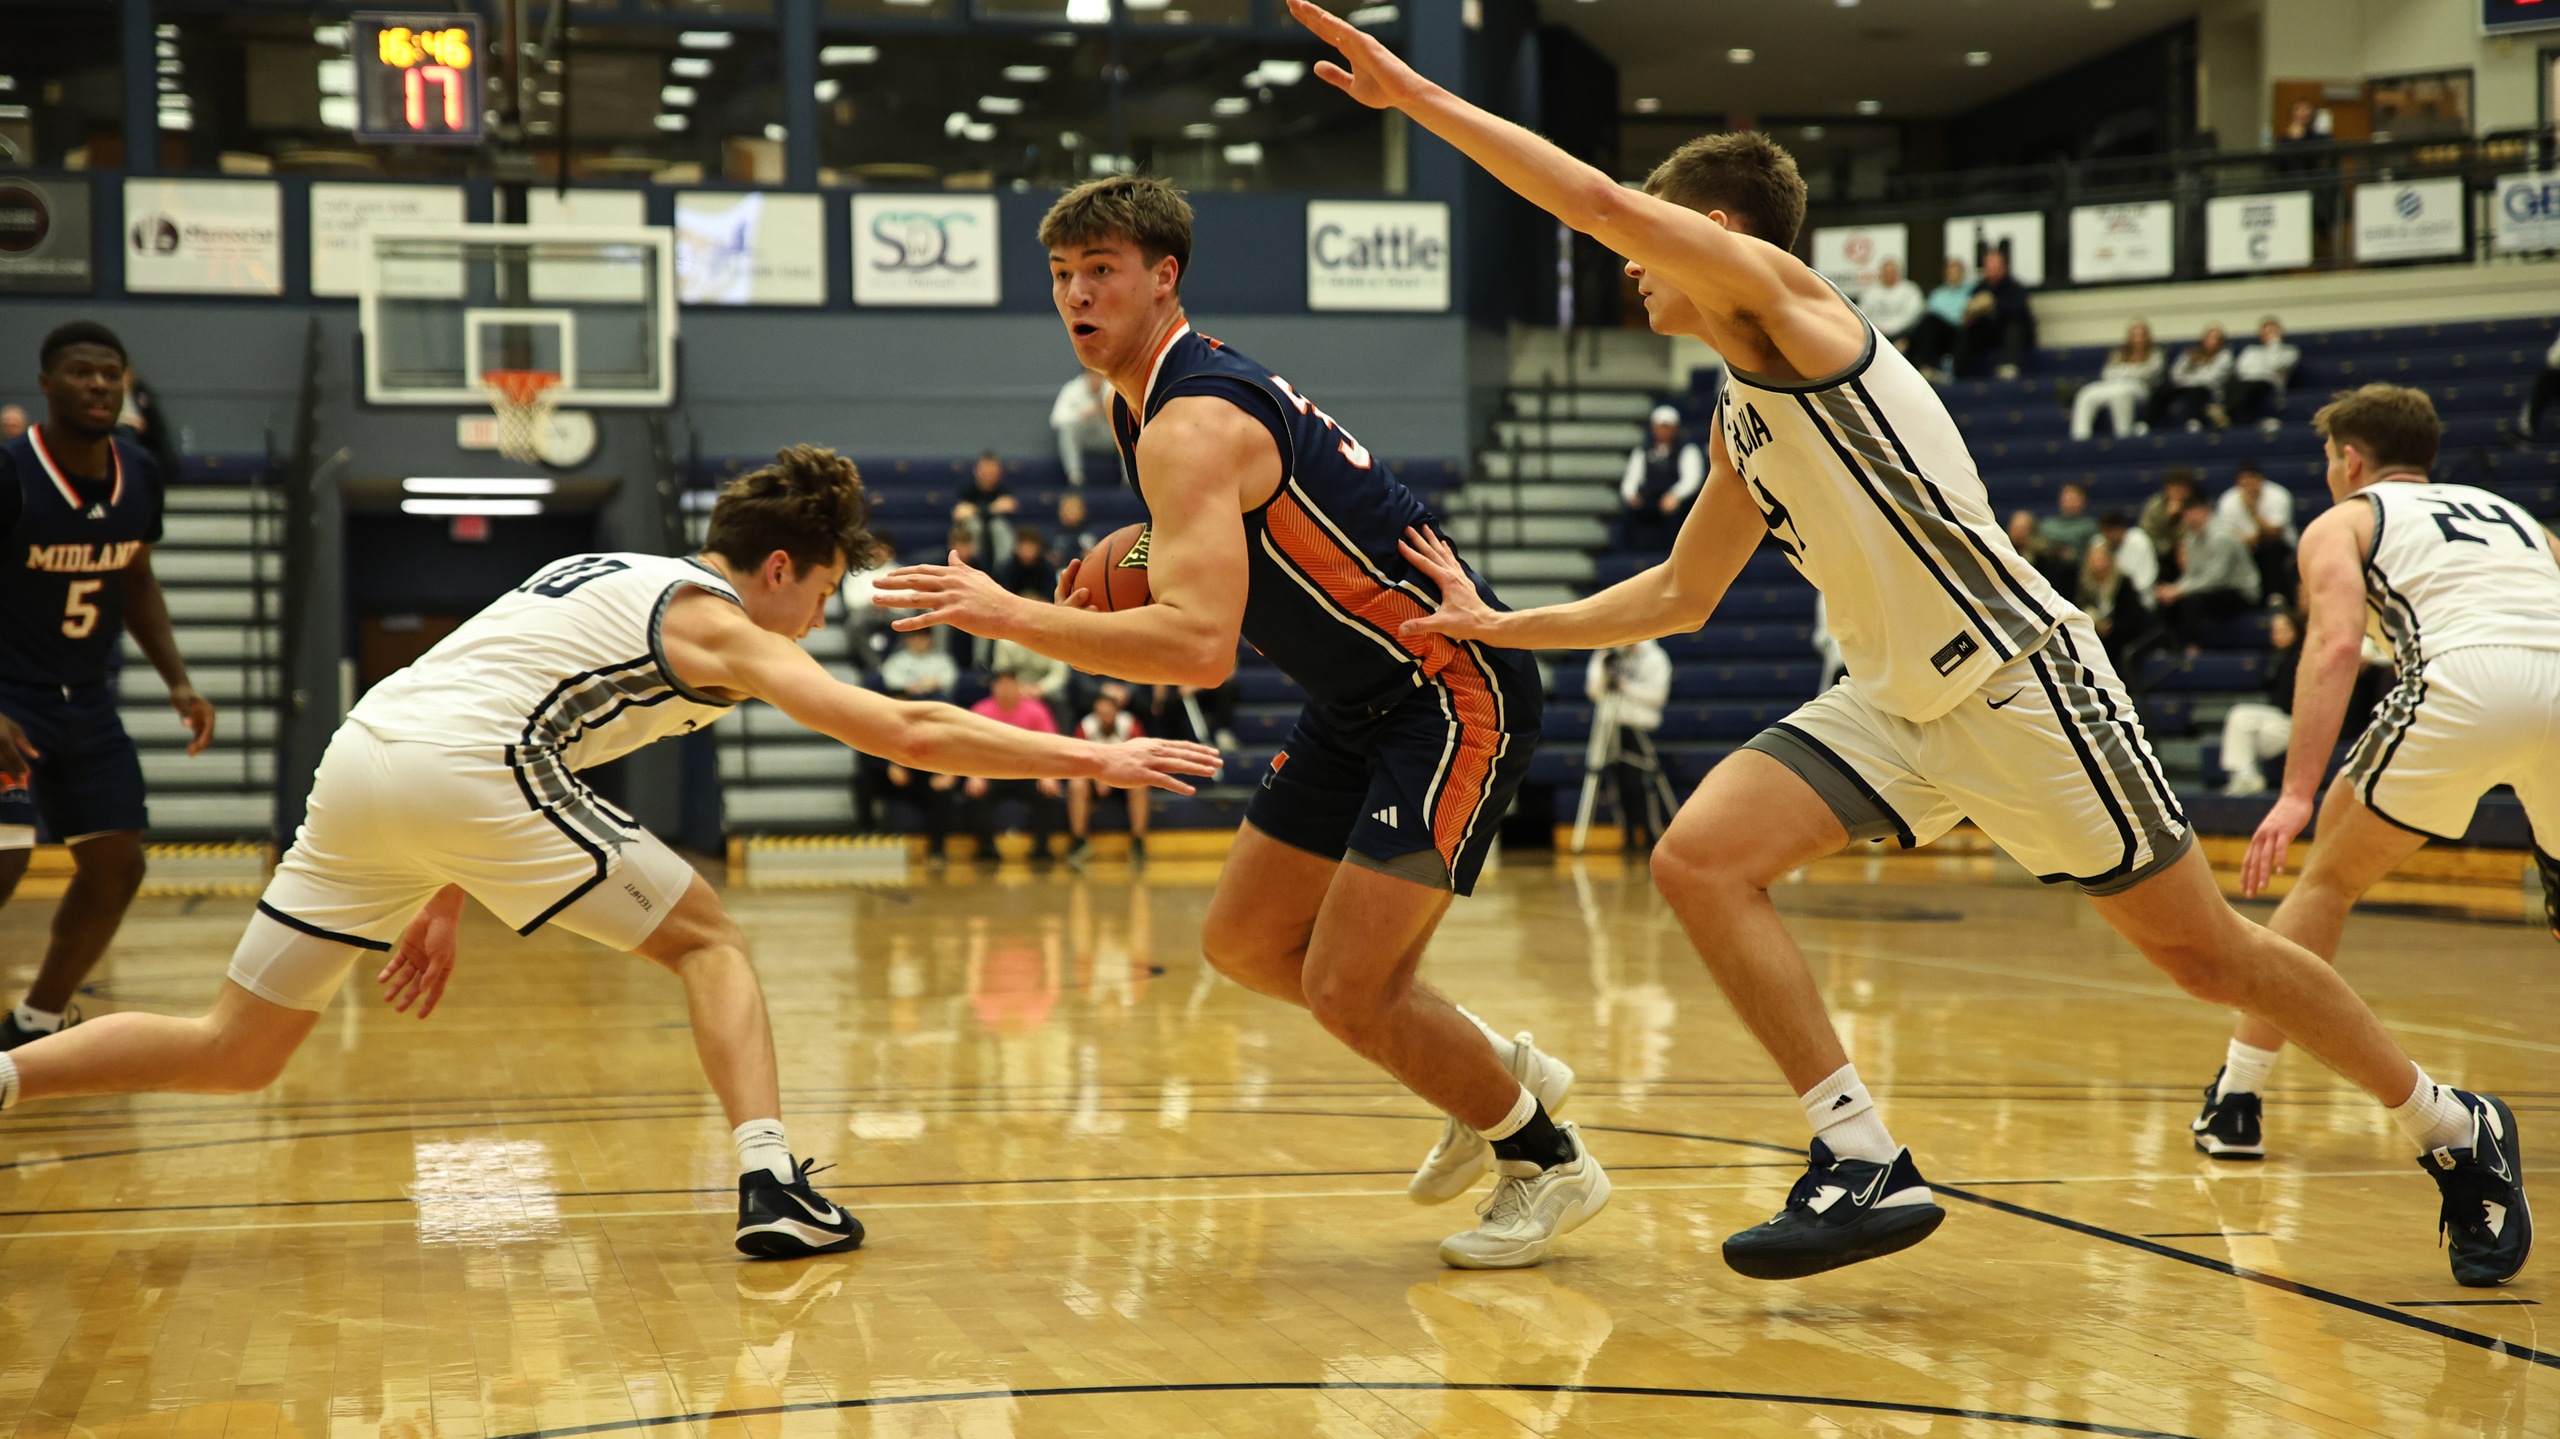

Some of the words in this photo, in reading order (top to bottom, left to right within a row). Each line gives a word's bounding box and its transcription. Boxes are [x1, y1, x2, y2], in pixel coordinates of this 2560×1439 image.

[379, 27, 472, 69] 16:46
[404, 64, 463, 130] 17
[1314, 223, 1441, 271] Cattle
[2416, 497, 2539, 552] 24
[25, 540, 142, 572] MIDLAN
[61, 578, 103, 639] 5
[1957, 640, 1970, 653] M
